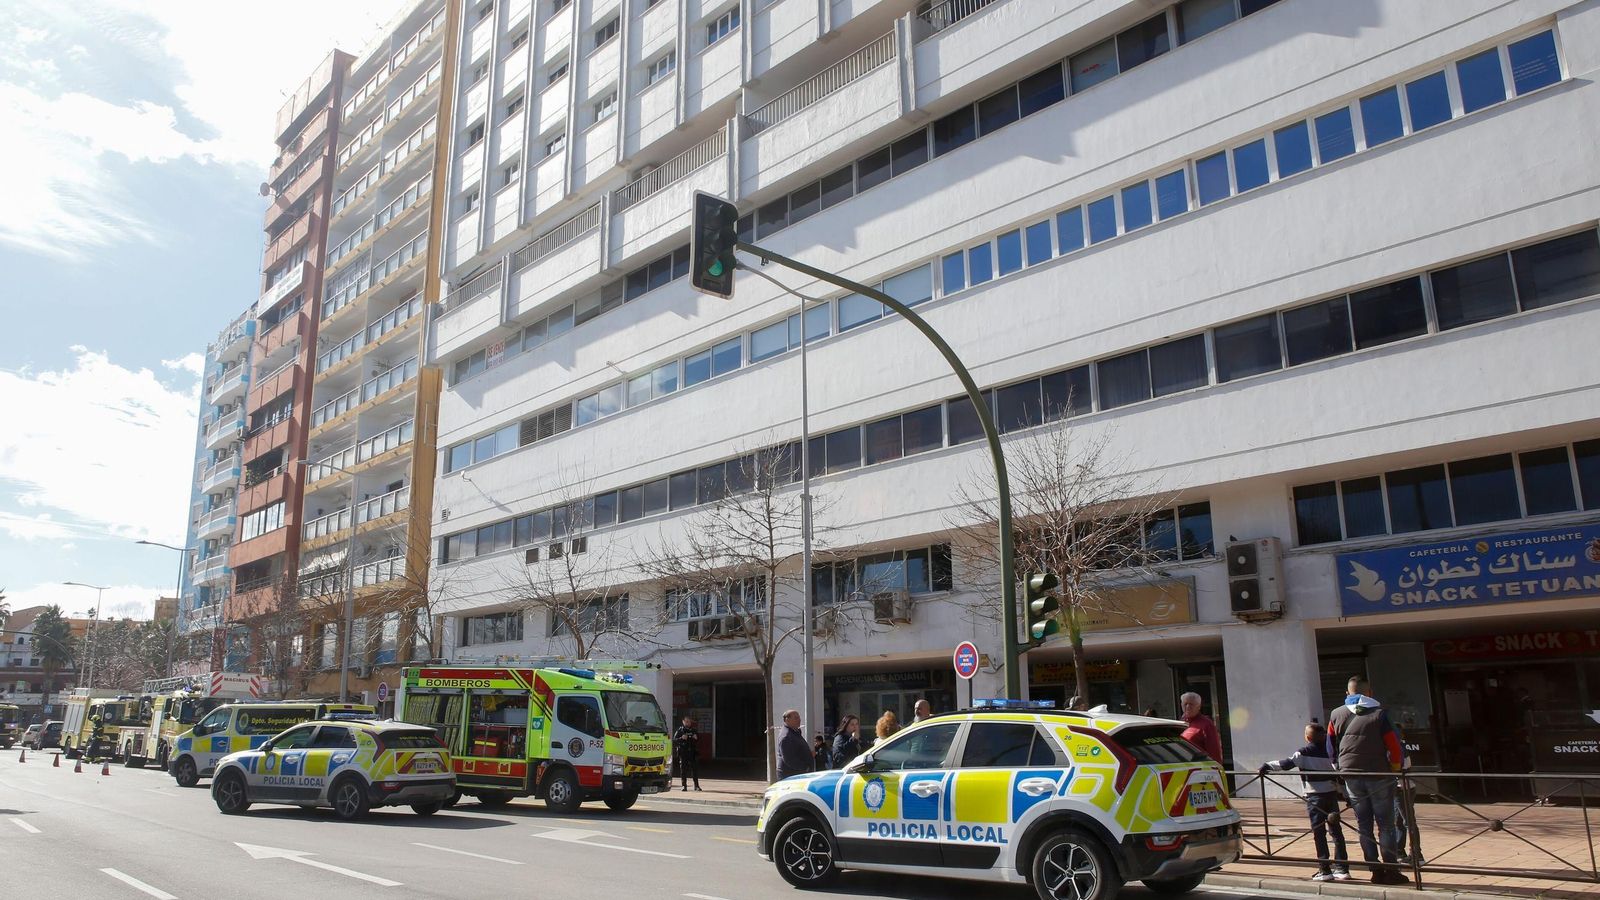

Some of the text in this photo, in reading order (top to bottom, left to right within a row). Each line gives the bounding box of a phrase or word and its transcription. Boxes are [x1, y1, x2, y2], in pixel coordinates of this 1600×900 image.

[1495, 532, 1583, 548] RESTAURANTE
[1398, 550, 1577, 588] سناك تطوان
[1390, 574, 1600, 606] SNACK TETUAN
[1495, 630, 1564, 652] SNACK
[426, 679, 491, 688] BOMBEROS
[836, 671, 926, 684] AGENCIA DE ADUANA
[589, 740, 604, 749] P-52
[1553, 745, 1599, 753] SNACK
[263, 776, 325, 787] POLICIA LOCAL
[1193, 792, 1207, 804] 6276
[867, 822, 1008, 844] POLICIA LOCAL
